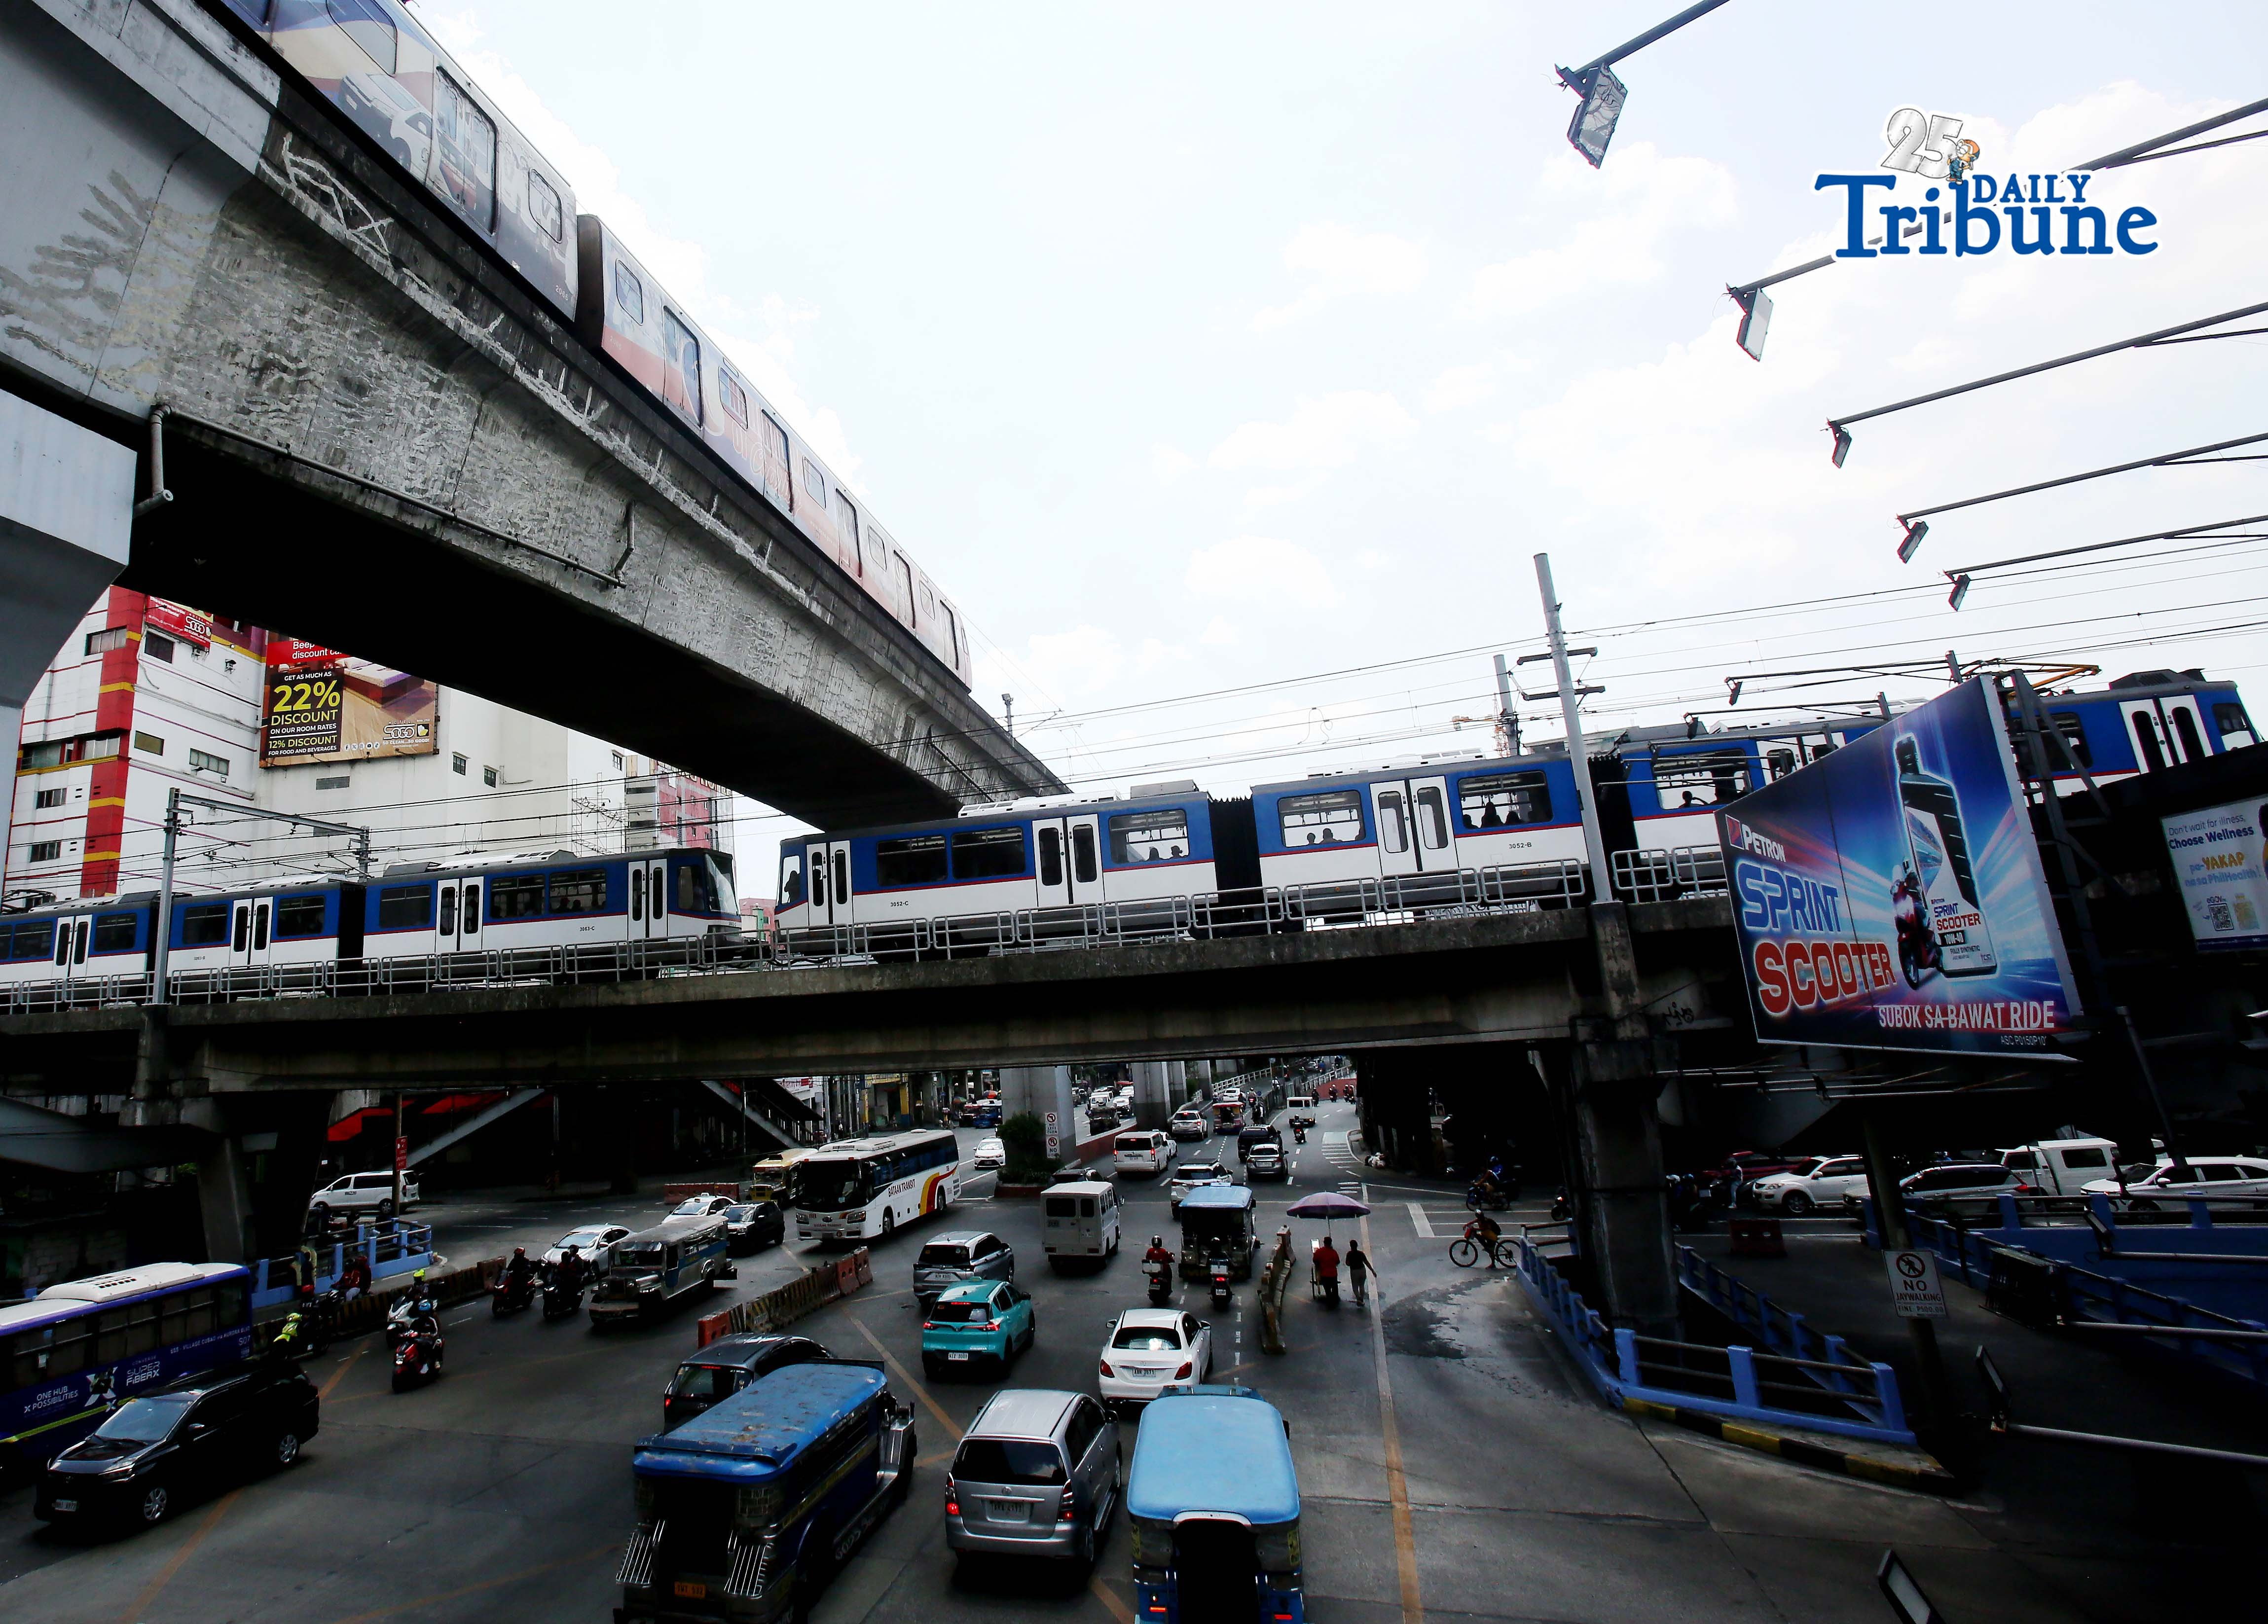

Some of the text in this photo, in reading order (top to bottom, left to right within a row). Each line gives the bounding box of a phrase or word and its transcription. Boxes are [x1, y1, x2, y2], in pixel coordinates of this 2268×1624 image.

[292, 648, 328, 659] discount
[273, 680, 340, 713] 22%
[271, 709, 338, 726] DISCOUNT
[383, 723, 415, 740] SOGO
[268, 735, 337, 749] 12% DISCOUNT
[2168, 814, 2246, 836] Don't wait for illness,
[1742, 824, 1786, 863] PETRON
[2169, 826, 2255, 850] Choose Wellness
[1736, 862, 1841, 932] SPRINT
[1934, 902, 1959, 918] SPRINT
[1937, 913, 1981, 931] SCOOTER
[1753, 941, 1897, 1016] SCOOTER
[1878, 1000, 2054, 1029] SUBOK SA BAWAT RIDE
[888, 1179, 915, 1197] BATAAN TRANSIT
[1903, 1279, 1927, 1292] NO
[1896, 1293, 1942, 1301] JAYWALKING
[127, 1361, 161, 1377] SUPER
[32, 1389, 79, 1412] POSSIBILITIES
[37, 1385, 68, 1401] ONE HUB
